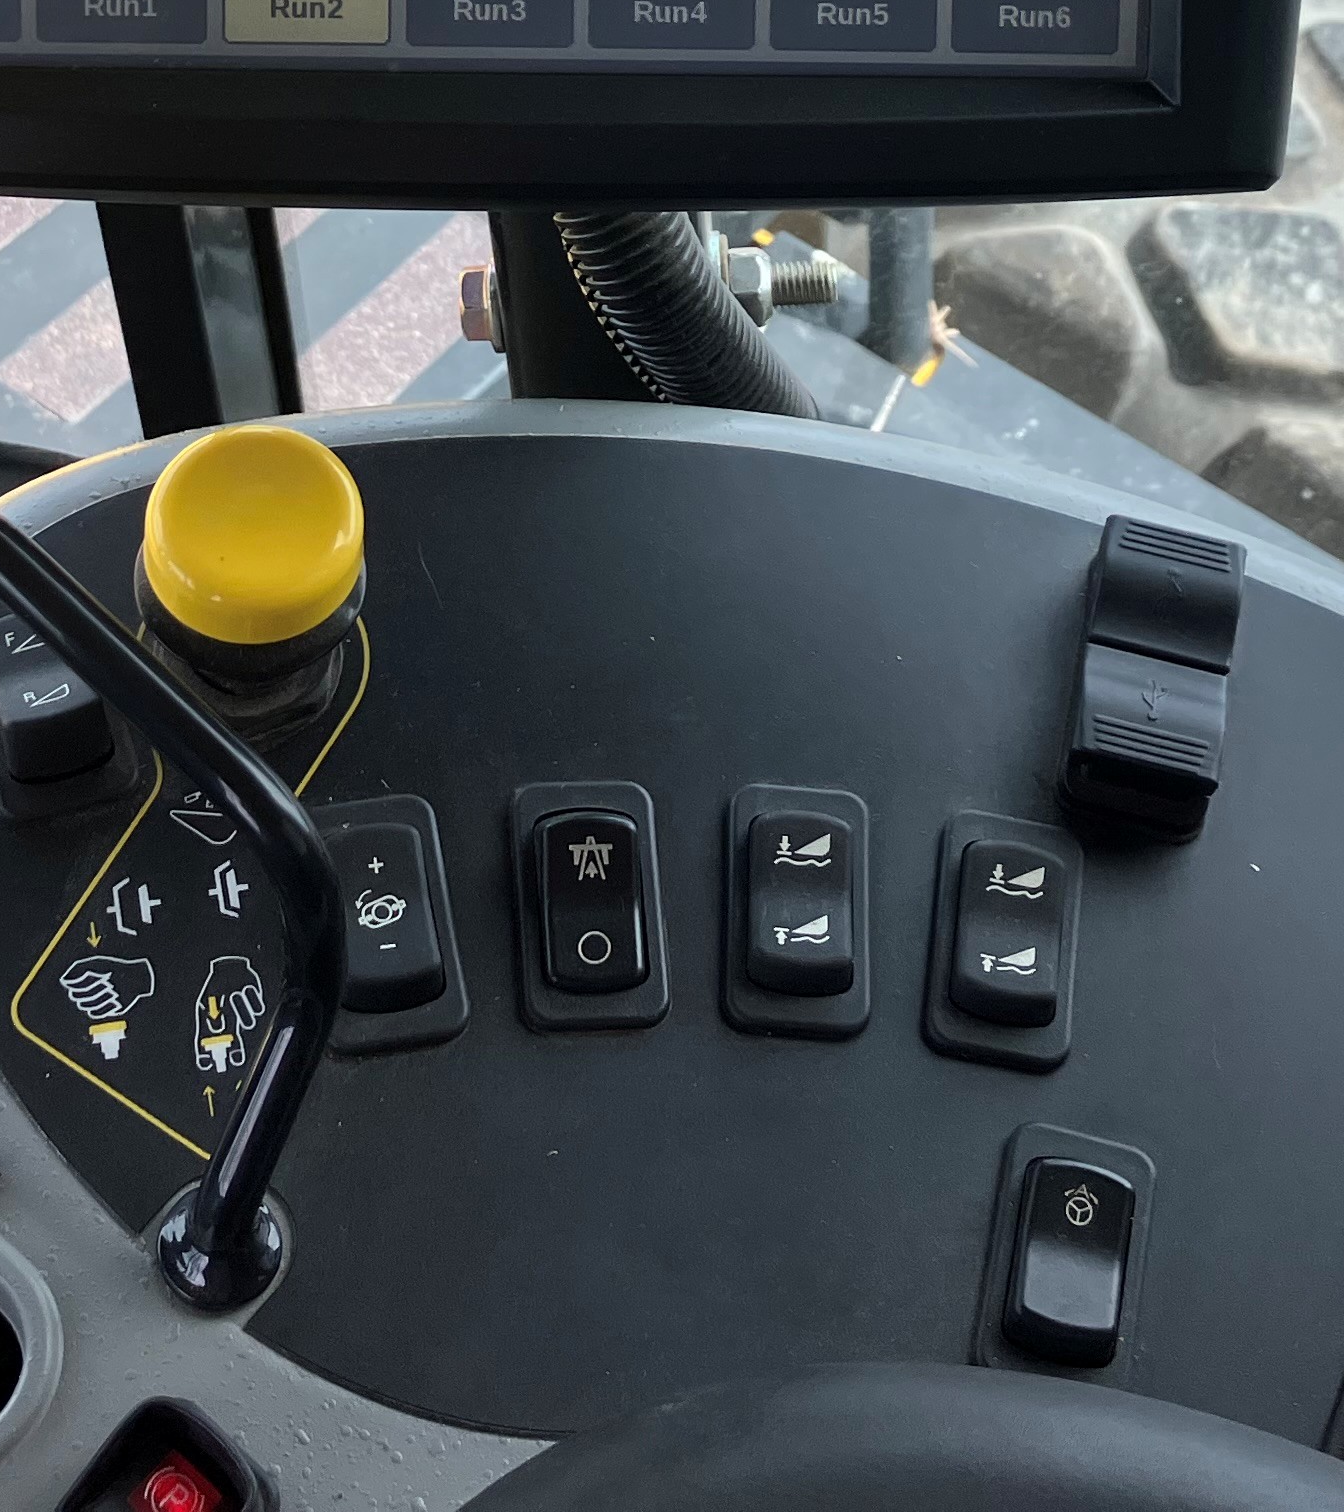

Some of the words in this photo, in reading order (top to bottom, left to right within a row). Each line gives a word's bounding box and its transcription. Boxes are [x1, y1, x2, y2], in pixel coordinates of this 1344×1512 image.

[632, 0, 708, 25] Run4
[816, 2, 890, 27] Run5
[998, 4, 1072, 29] Run6
